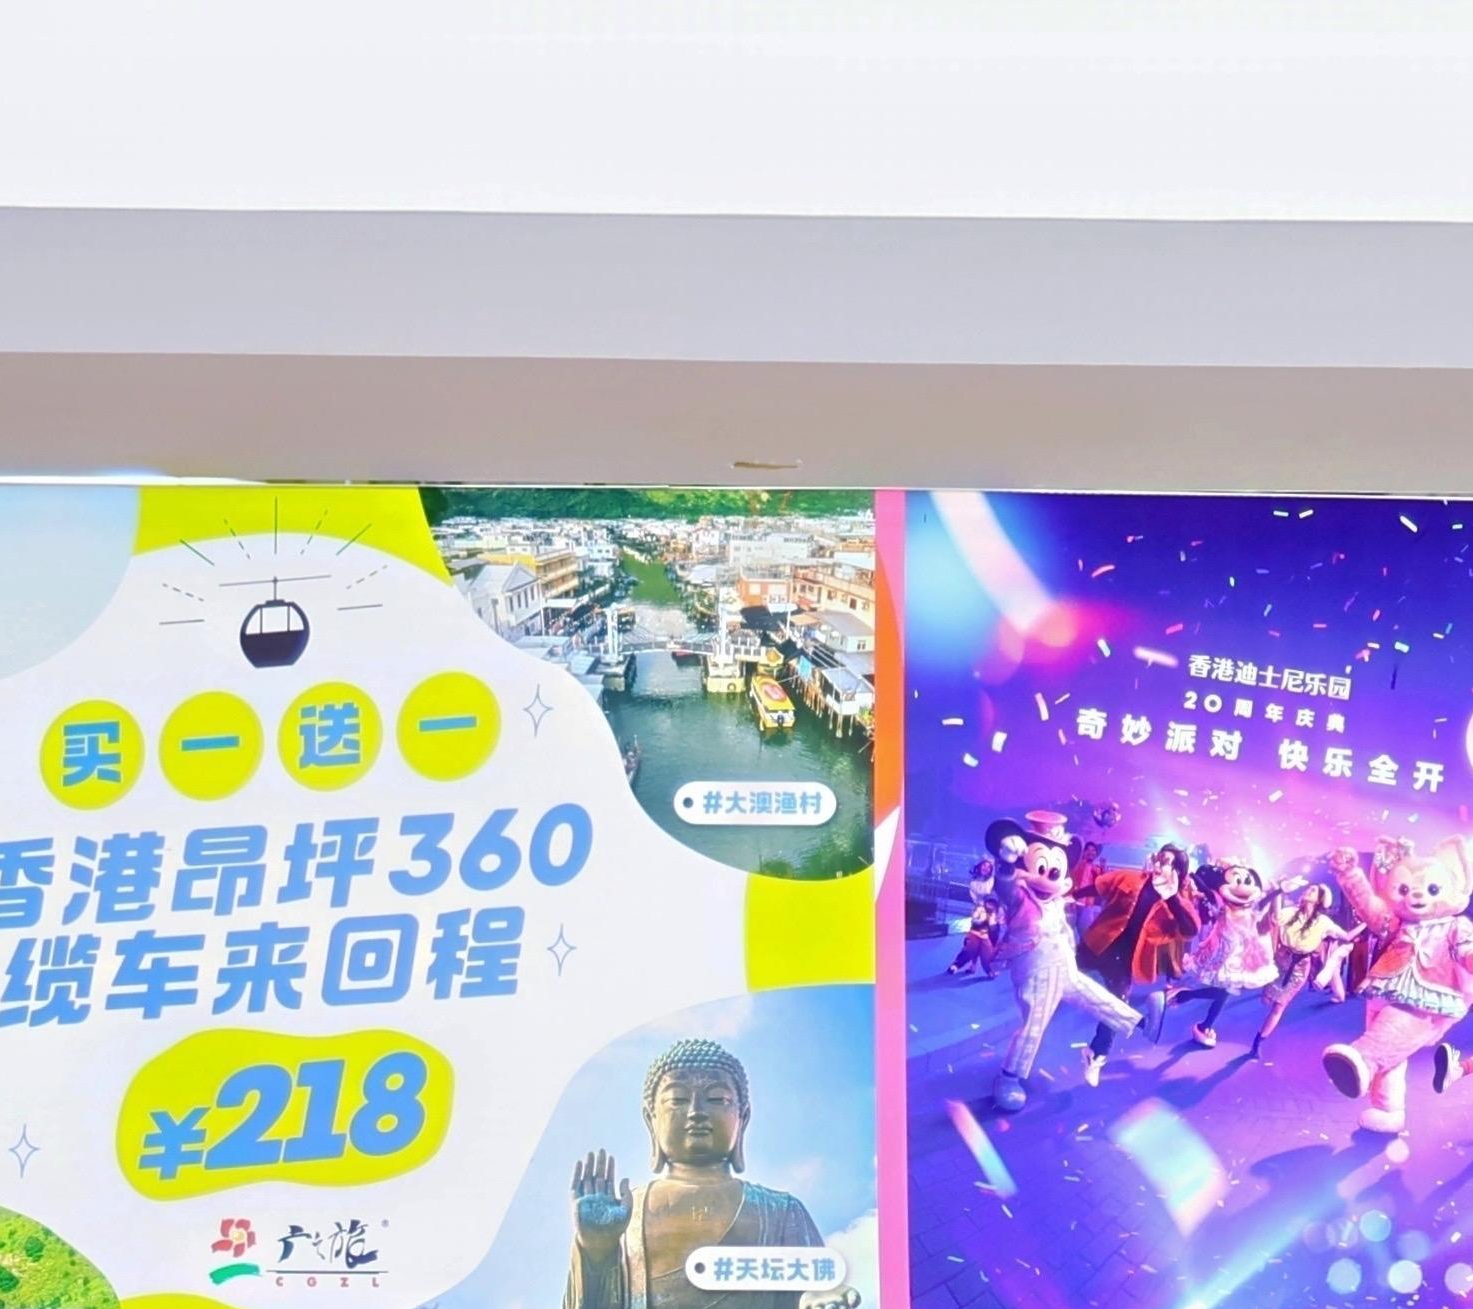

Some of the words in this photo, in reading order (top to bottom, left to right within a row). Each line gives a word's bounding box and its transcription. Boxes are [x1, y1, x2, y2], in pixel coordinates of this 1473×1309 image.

[1189, 653, 1352, 701] 香港迪士尼乐园
[1076, 708, 1241, 762] 奇妙派对
[1279, 738, 1446, 792] 快乐全开
[701, 790, 822, 816] #大澳渔村
[140, 1052, 425, 1180] ¥218
[713, 1256, 835, 1282] #天坛大佛
